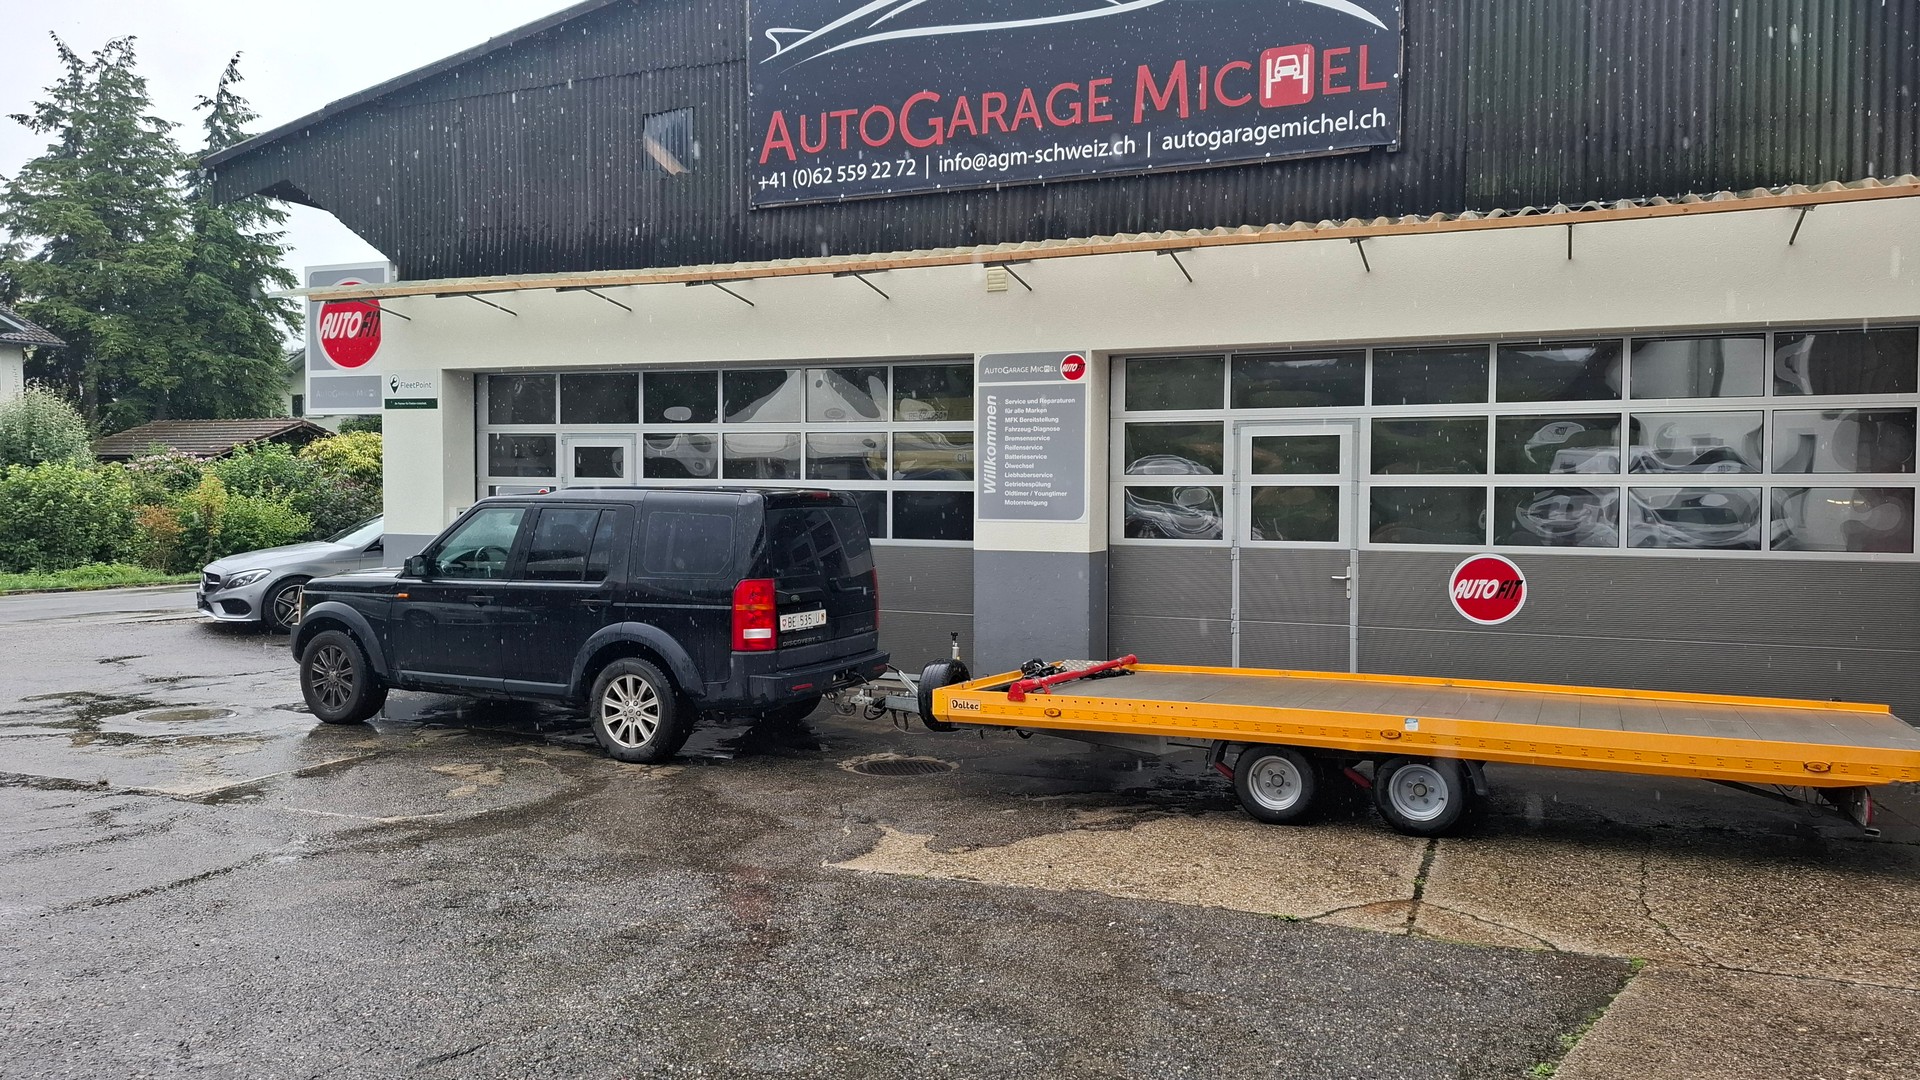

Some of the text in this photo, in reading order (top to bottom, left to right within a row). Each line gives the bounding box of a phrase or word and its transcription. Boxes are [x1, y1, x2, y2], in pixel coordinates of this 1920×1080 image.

[758, 172, 786, 190] +41
[792, 167, 832, 189] (0)62
[837, 164, 867, 183] 559
[871, 161, 891, 180] 22
[896, 159, 916, 176] 72
[939, 134, 1136, 173] info@agm-schweiz.ch
[1161, 107, 1386, 150] autogaragemichel.ch
[400, 381, 432, 389] FleetPoint
[984, 395, 997, 494] Willkommen
[1455, 579, 1523, 599] AUTOFIT
[788, 616, 796, 628] BE
[782, 637, 816, 647] DISCOVERY
